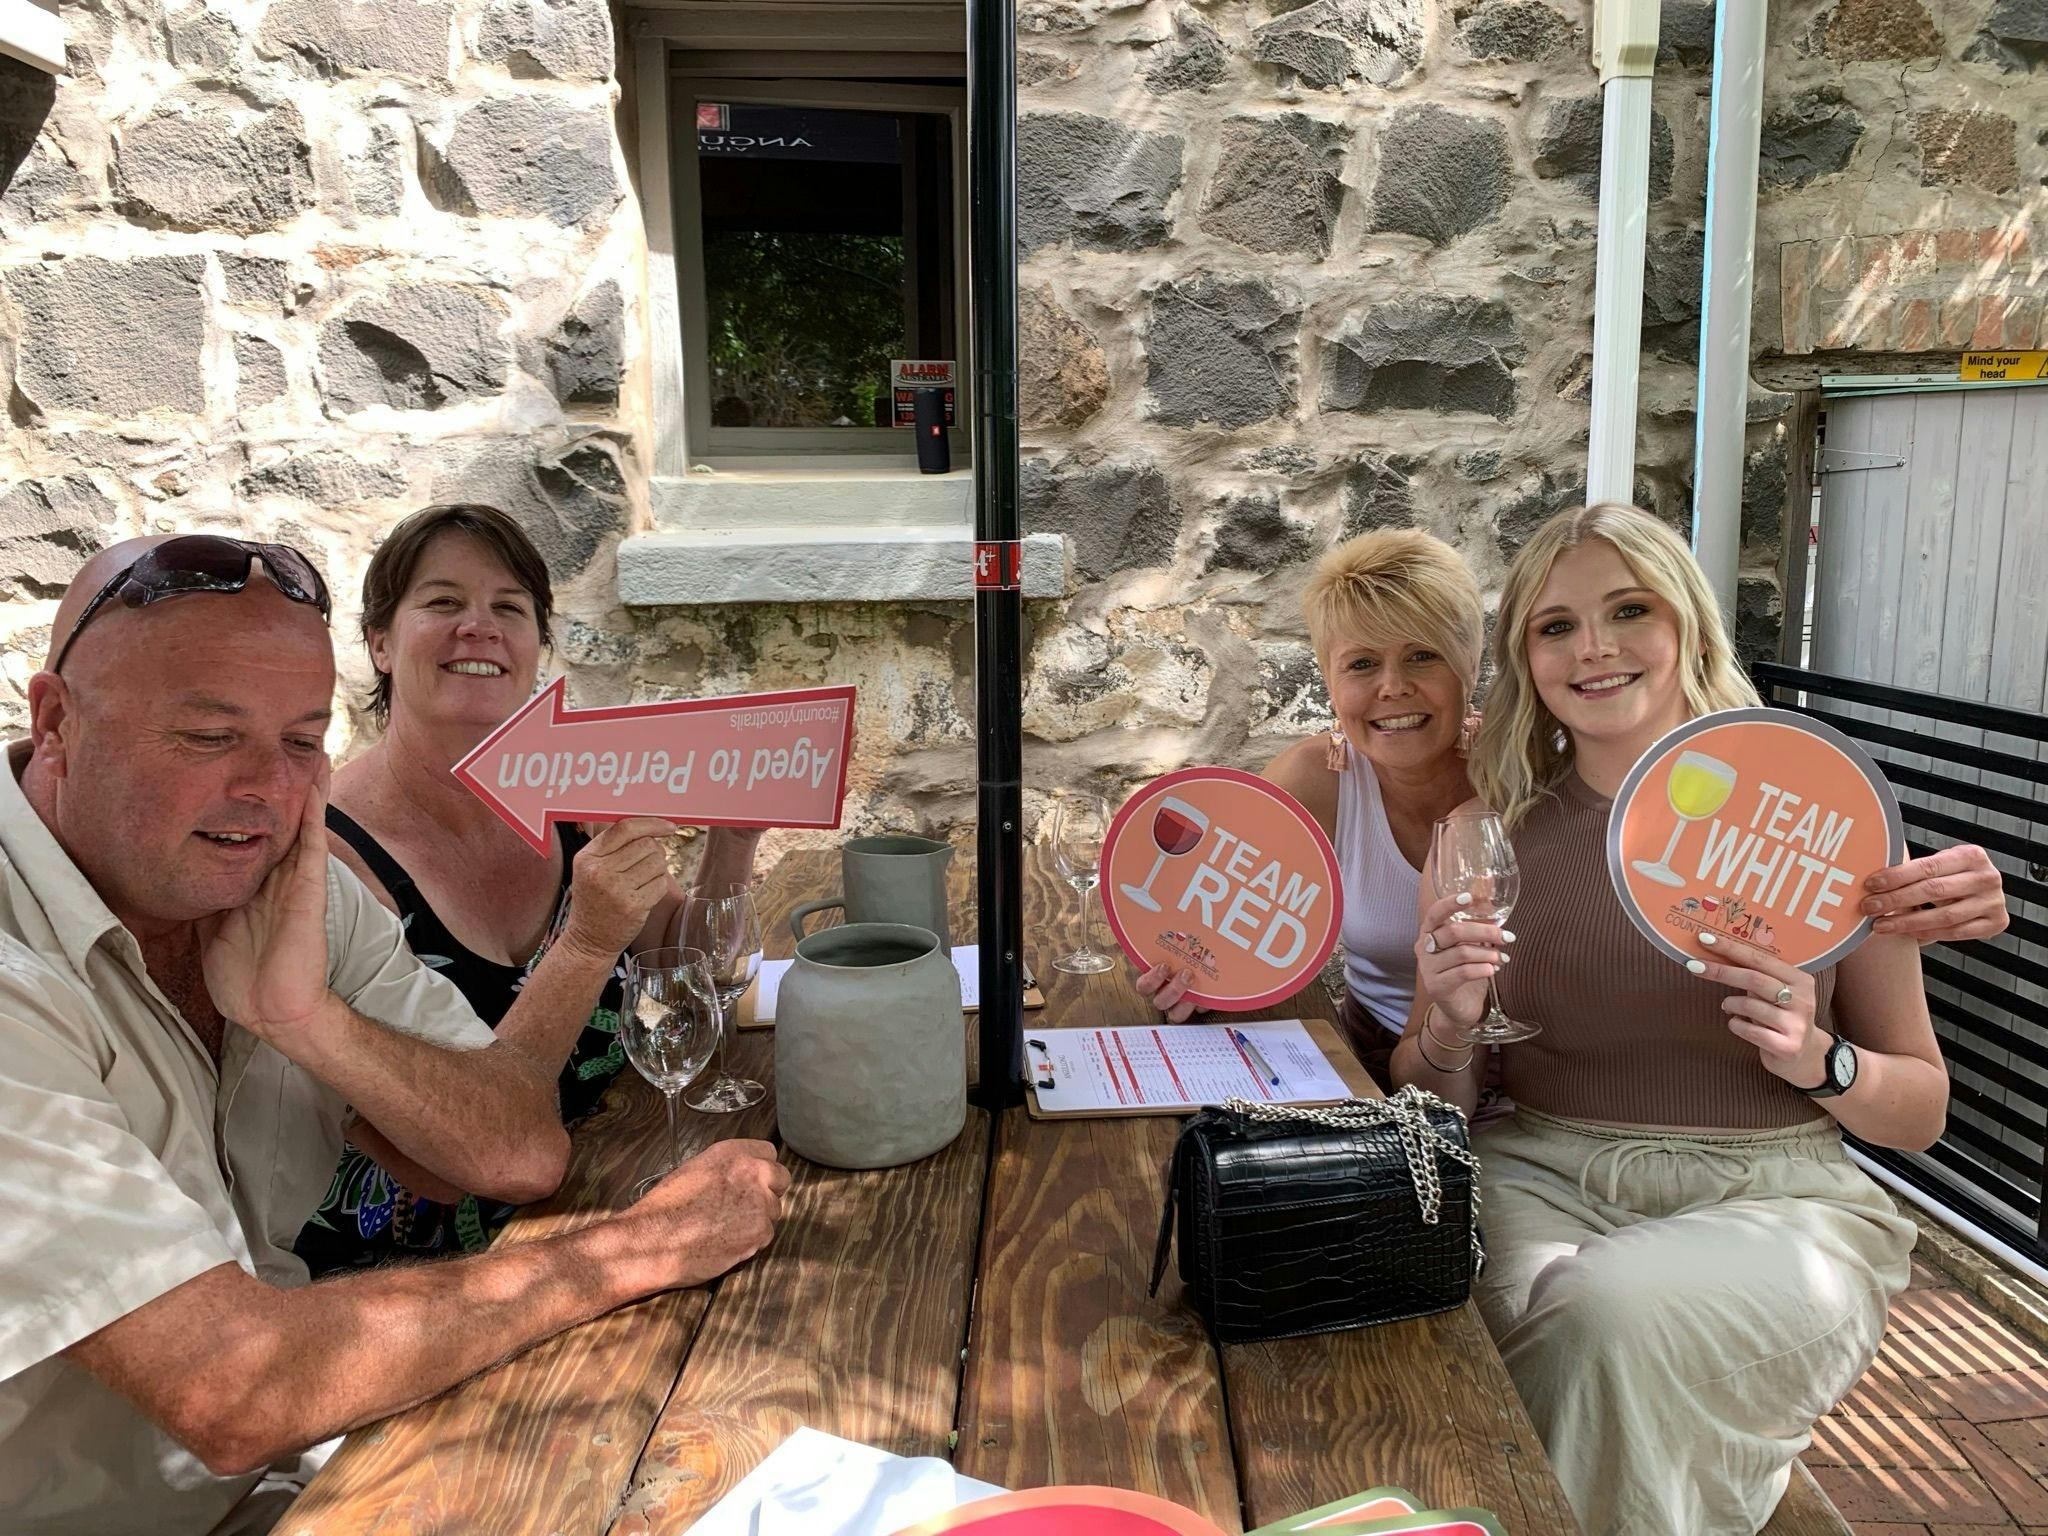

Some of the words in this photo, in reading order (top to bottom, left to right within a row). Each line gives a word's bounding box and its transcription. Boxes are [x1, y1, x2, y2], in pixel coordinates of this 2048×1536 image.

[899, 363, 950, 376] ALARM
[1968, 356, 1994, 366] Mind
[1997, 357, 2021, 368] your
[1980, 369, 2006, 379] head
[730, 705, 840, 732] #countryfoodtrails
[498, 750, 696, 799] Perfection
[709, 748, 741, 790] to
[746, 737, 835, 792] Aged
[1750, 782, 1854, 862] TEAM
[1208, 826, 1322, 918] TEAM
[1696, 819, 1856, 933] WHITE
[1177, 863, 1307, 969] RED
[1155, 938, 1182, 958] COUNTRY
[1182, 954, 1200, 969] FOOD
